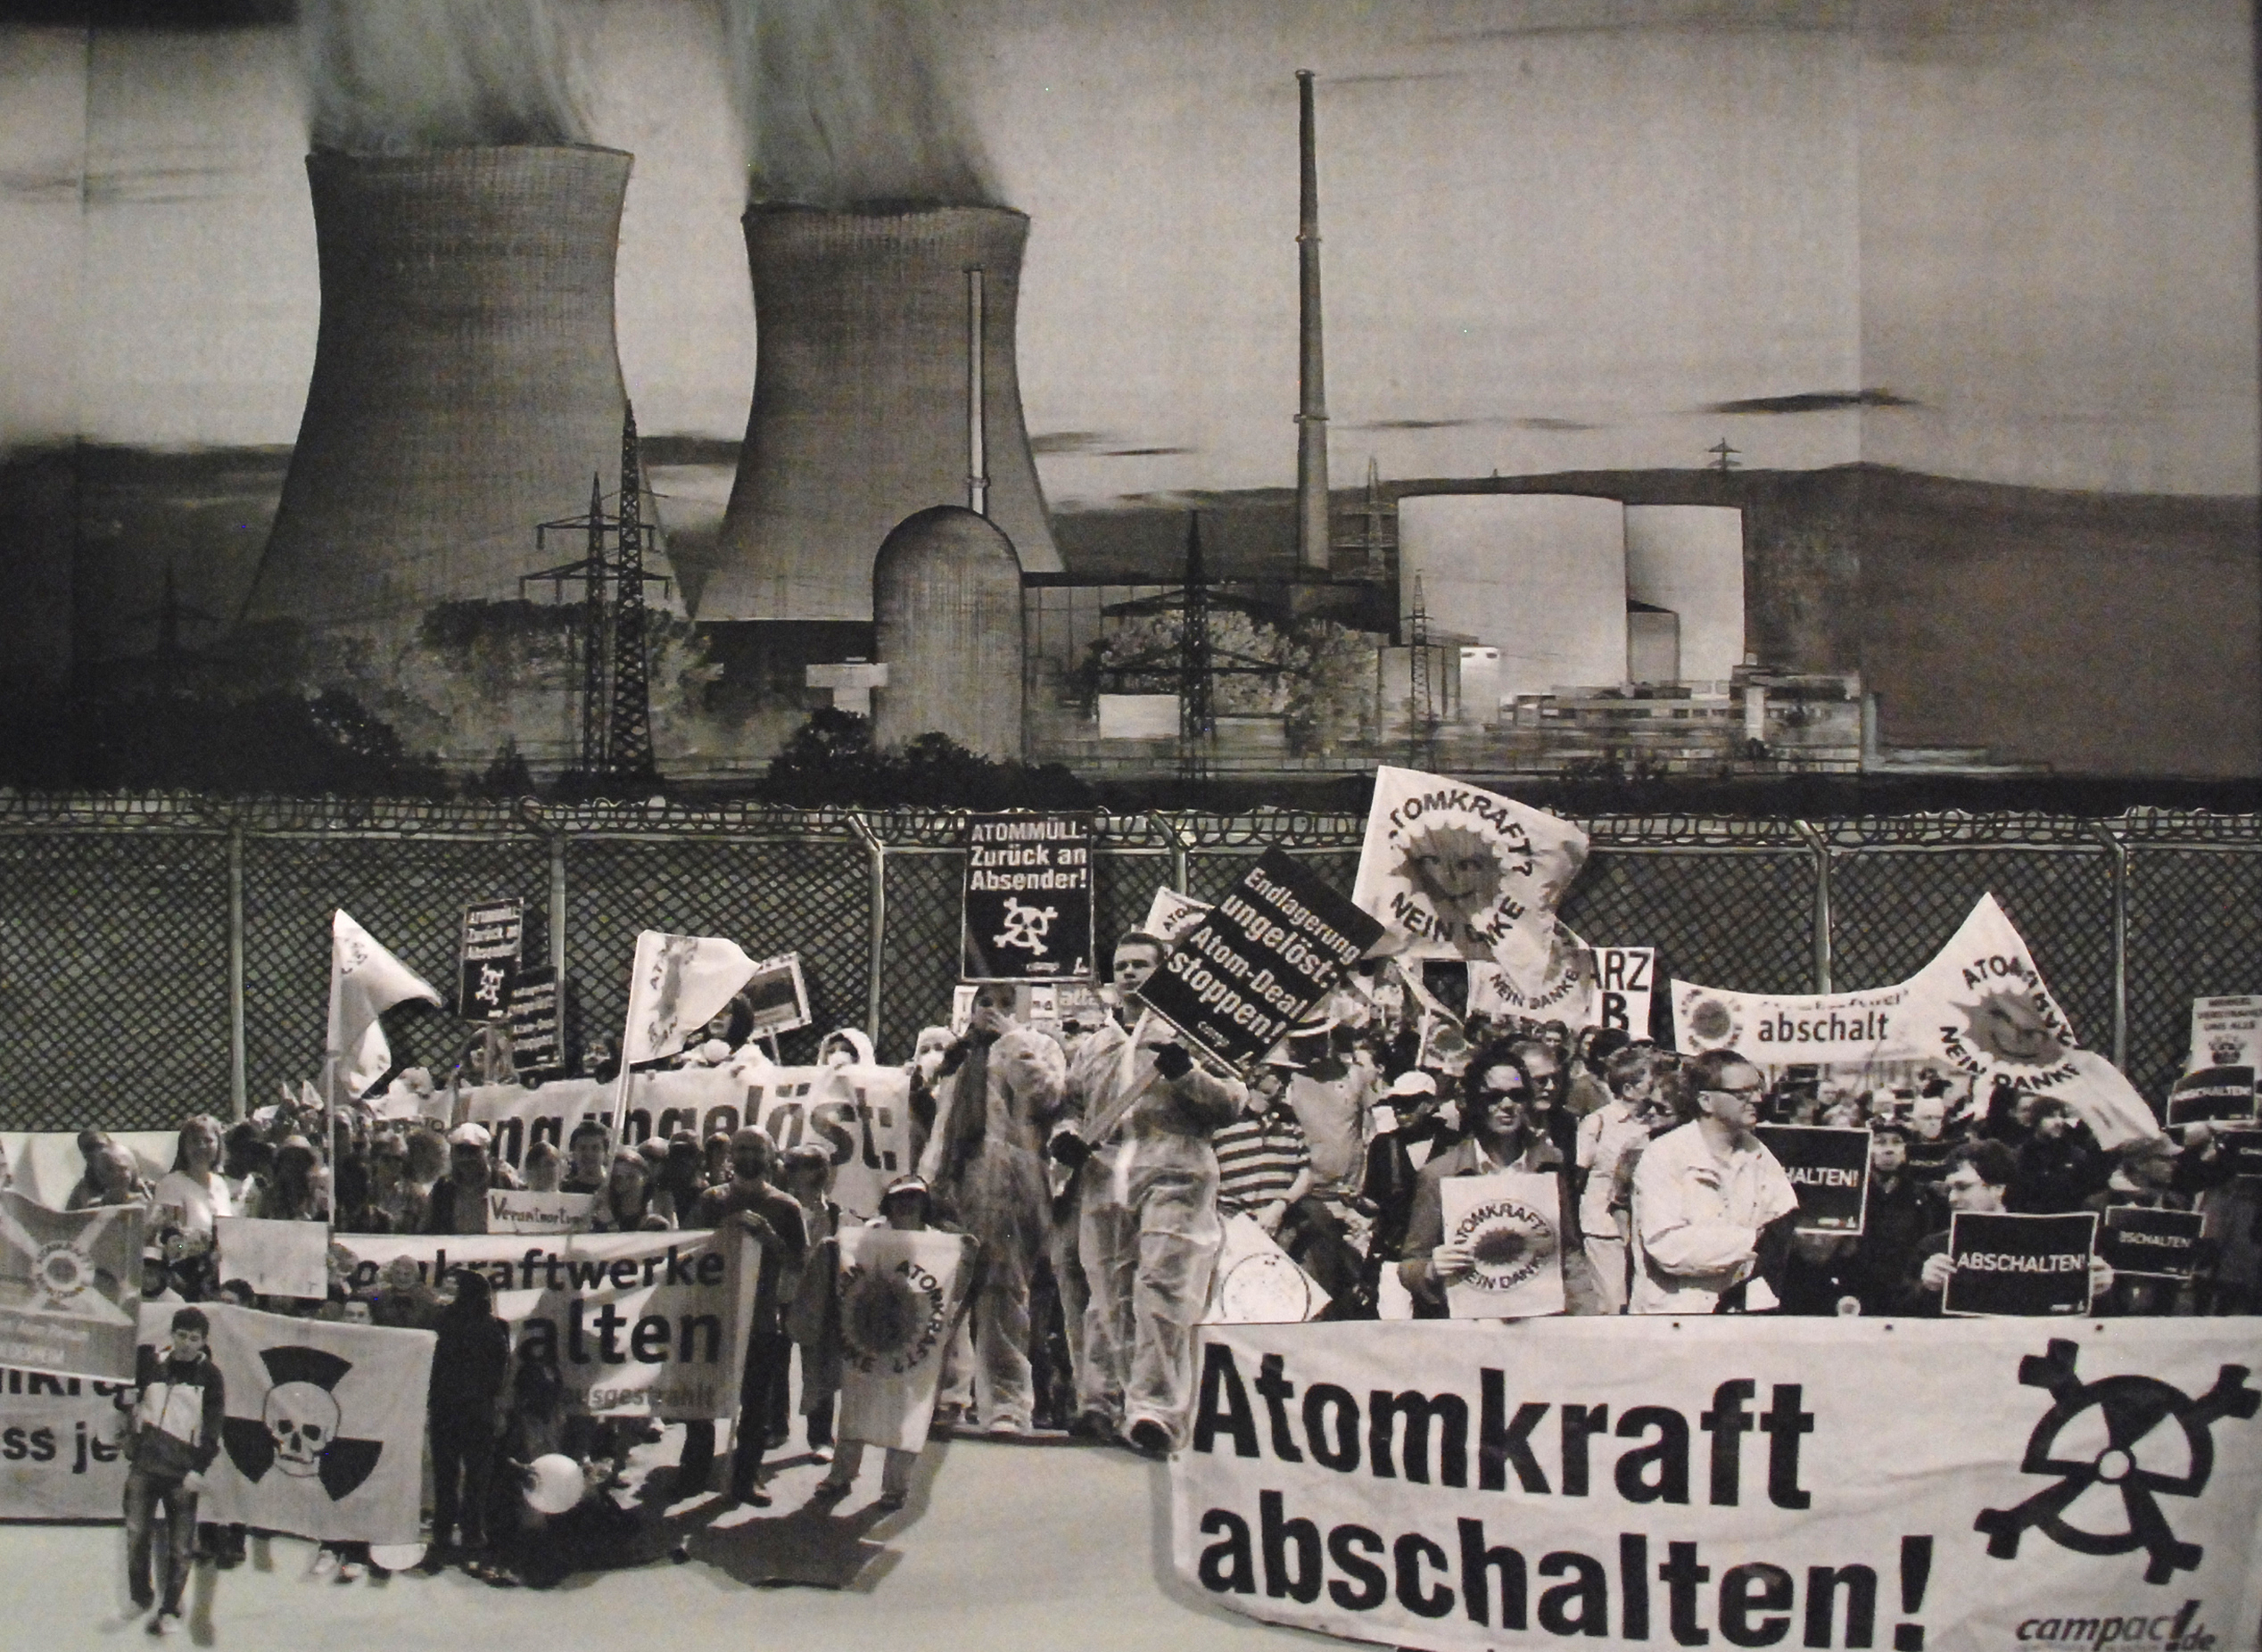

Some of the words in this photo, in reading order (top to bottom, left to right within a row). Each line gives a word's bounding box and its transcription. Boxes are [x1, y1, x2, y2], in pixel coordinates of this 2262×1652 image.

[970, 843, 1051, 867] Zurück
[1056, 847, 1088, 866] an
[970, 867, 1088, 891] Absender!
[1219, 894, 1338, 988] ungelöst:
[1244, 866, 1361, 966] Endlagerung
[1167, 951, 1287, 1045] stoppen!
[1190, 925, 1308, 1020] Atom-Deal
[1757, 1011, 1890, 1043] abschalt
[1193, 1342, 1816, 1510] Atomkraft
[1197, 1490, 1934, 1652] abschalten!
